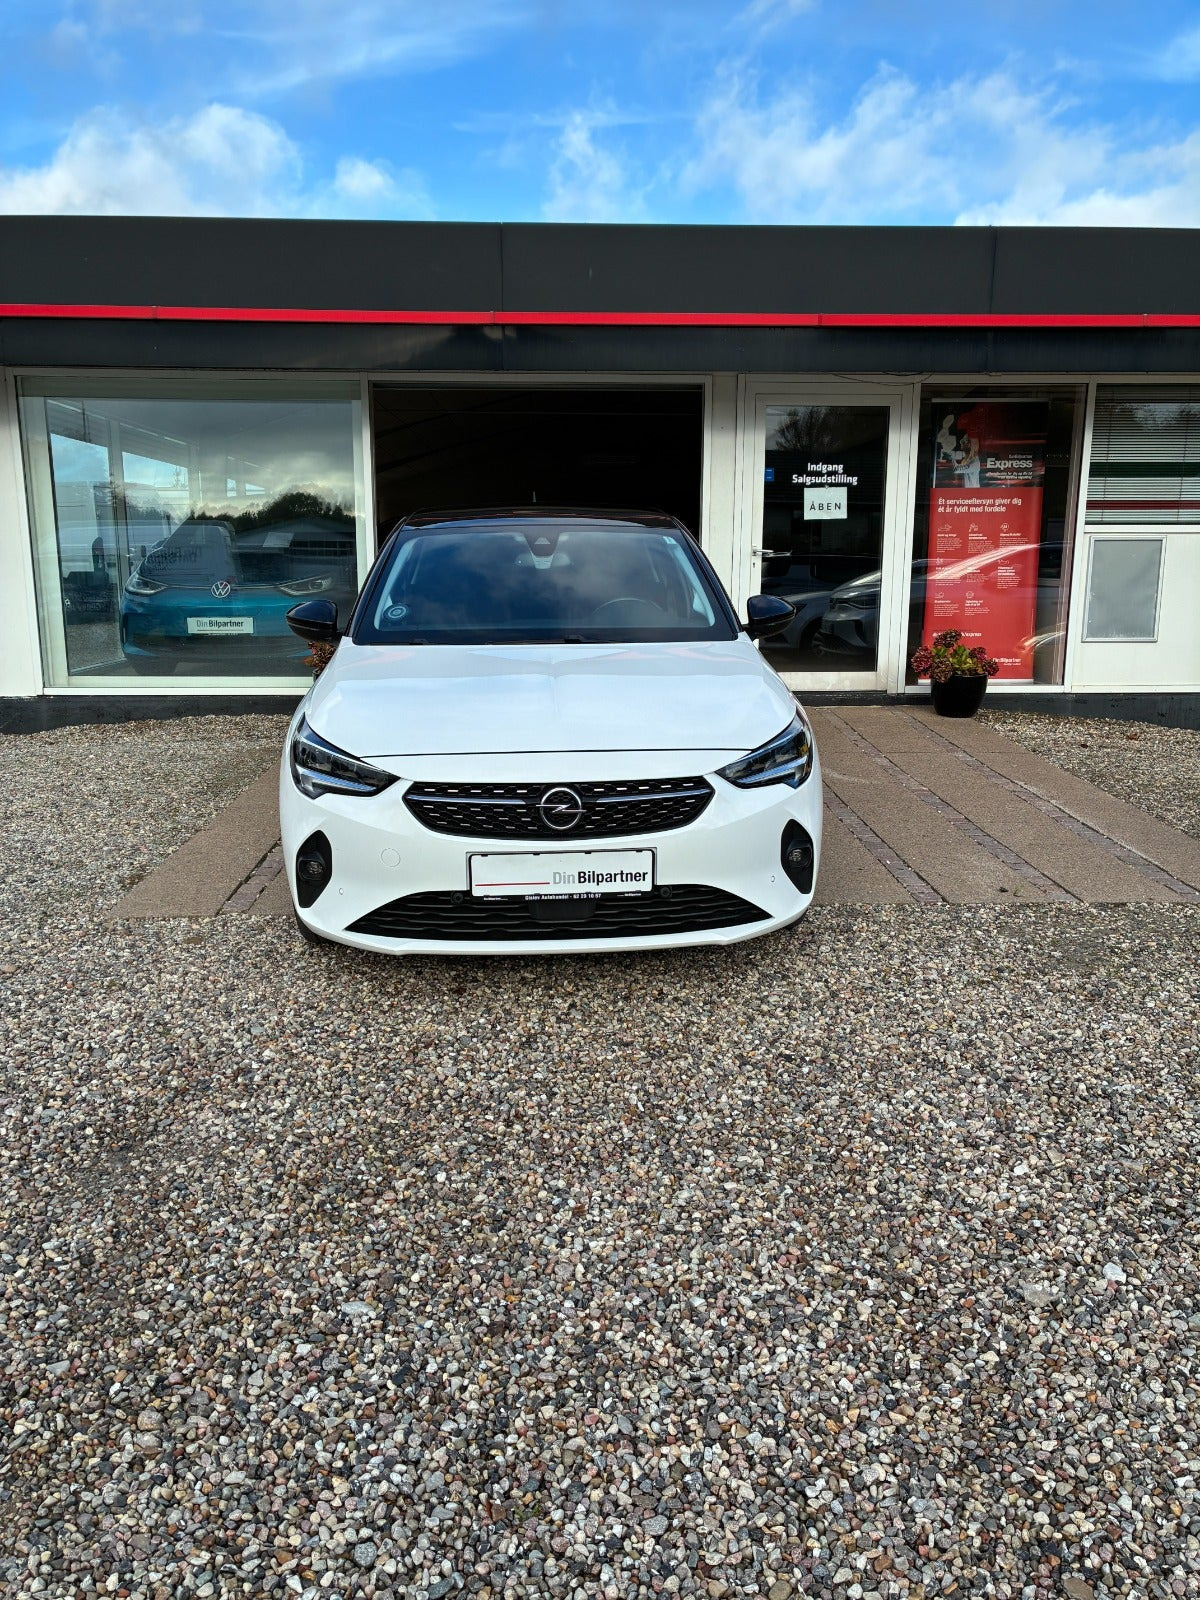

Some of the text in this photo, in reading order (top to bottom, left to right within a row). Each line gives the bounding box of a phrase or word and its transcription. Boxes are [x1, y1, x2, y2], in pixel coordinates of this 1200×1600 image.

[807, 462, 844, 473] Indgang
[986, 458, 1033, 470] Express
[792, 474, 858, 485] Salgsudstilling
[809, 502, 842, 511] ÅBEN
[1012, 498, 1022, 506] dig
[577, 870, 649, 886] Bilpartner
